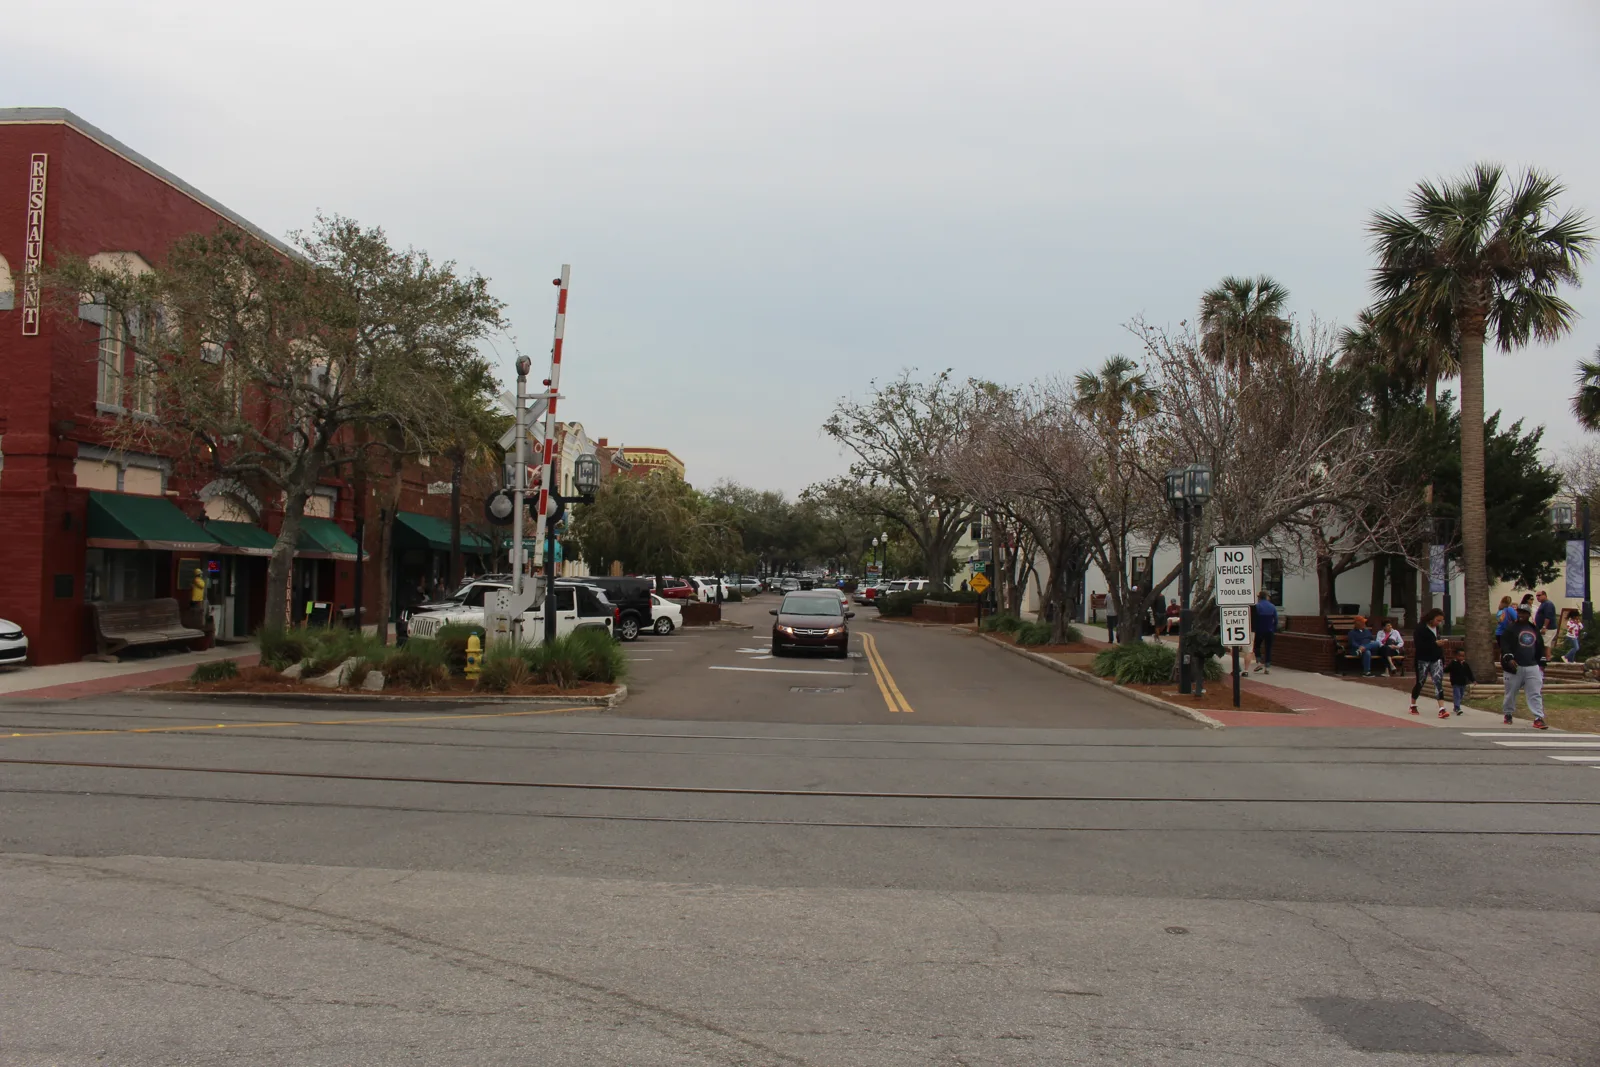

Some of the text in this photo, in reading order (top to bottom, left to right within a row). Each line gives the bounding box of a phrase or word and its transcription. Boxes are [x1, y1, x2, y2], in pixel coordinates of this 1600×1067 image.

[25, 161, 44, 323] RESTAURANT
[1224, 551, 1244, 562] NO
[1217, 565, 1252, 574] VEHICLES
[1226, 627, 1246, 641] 15
